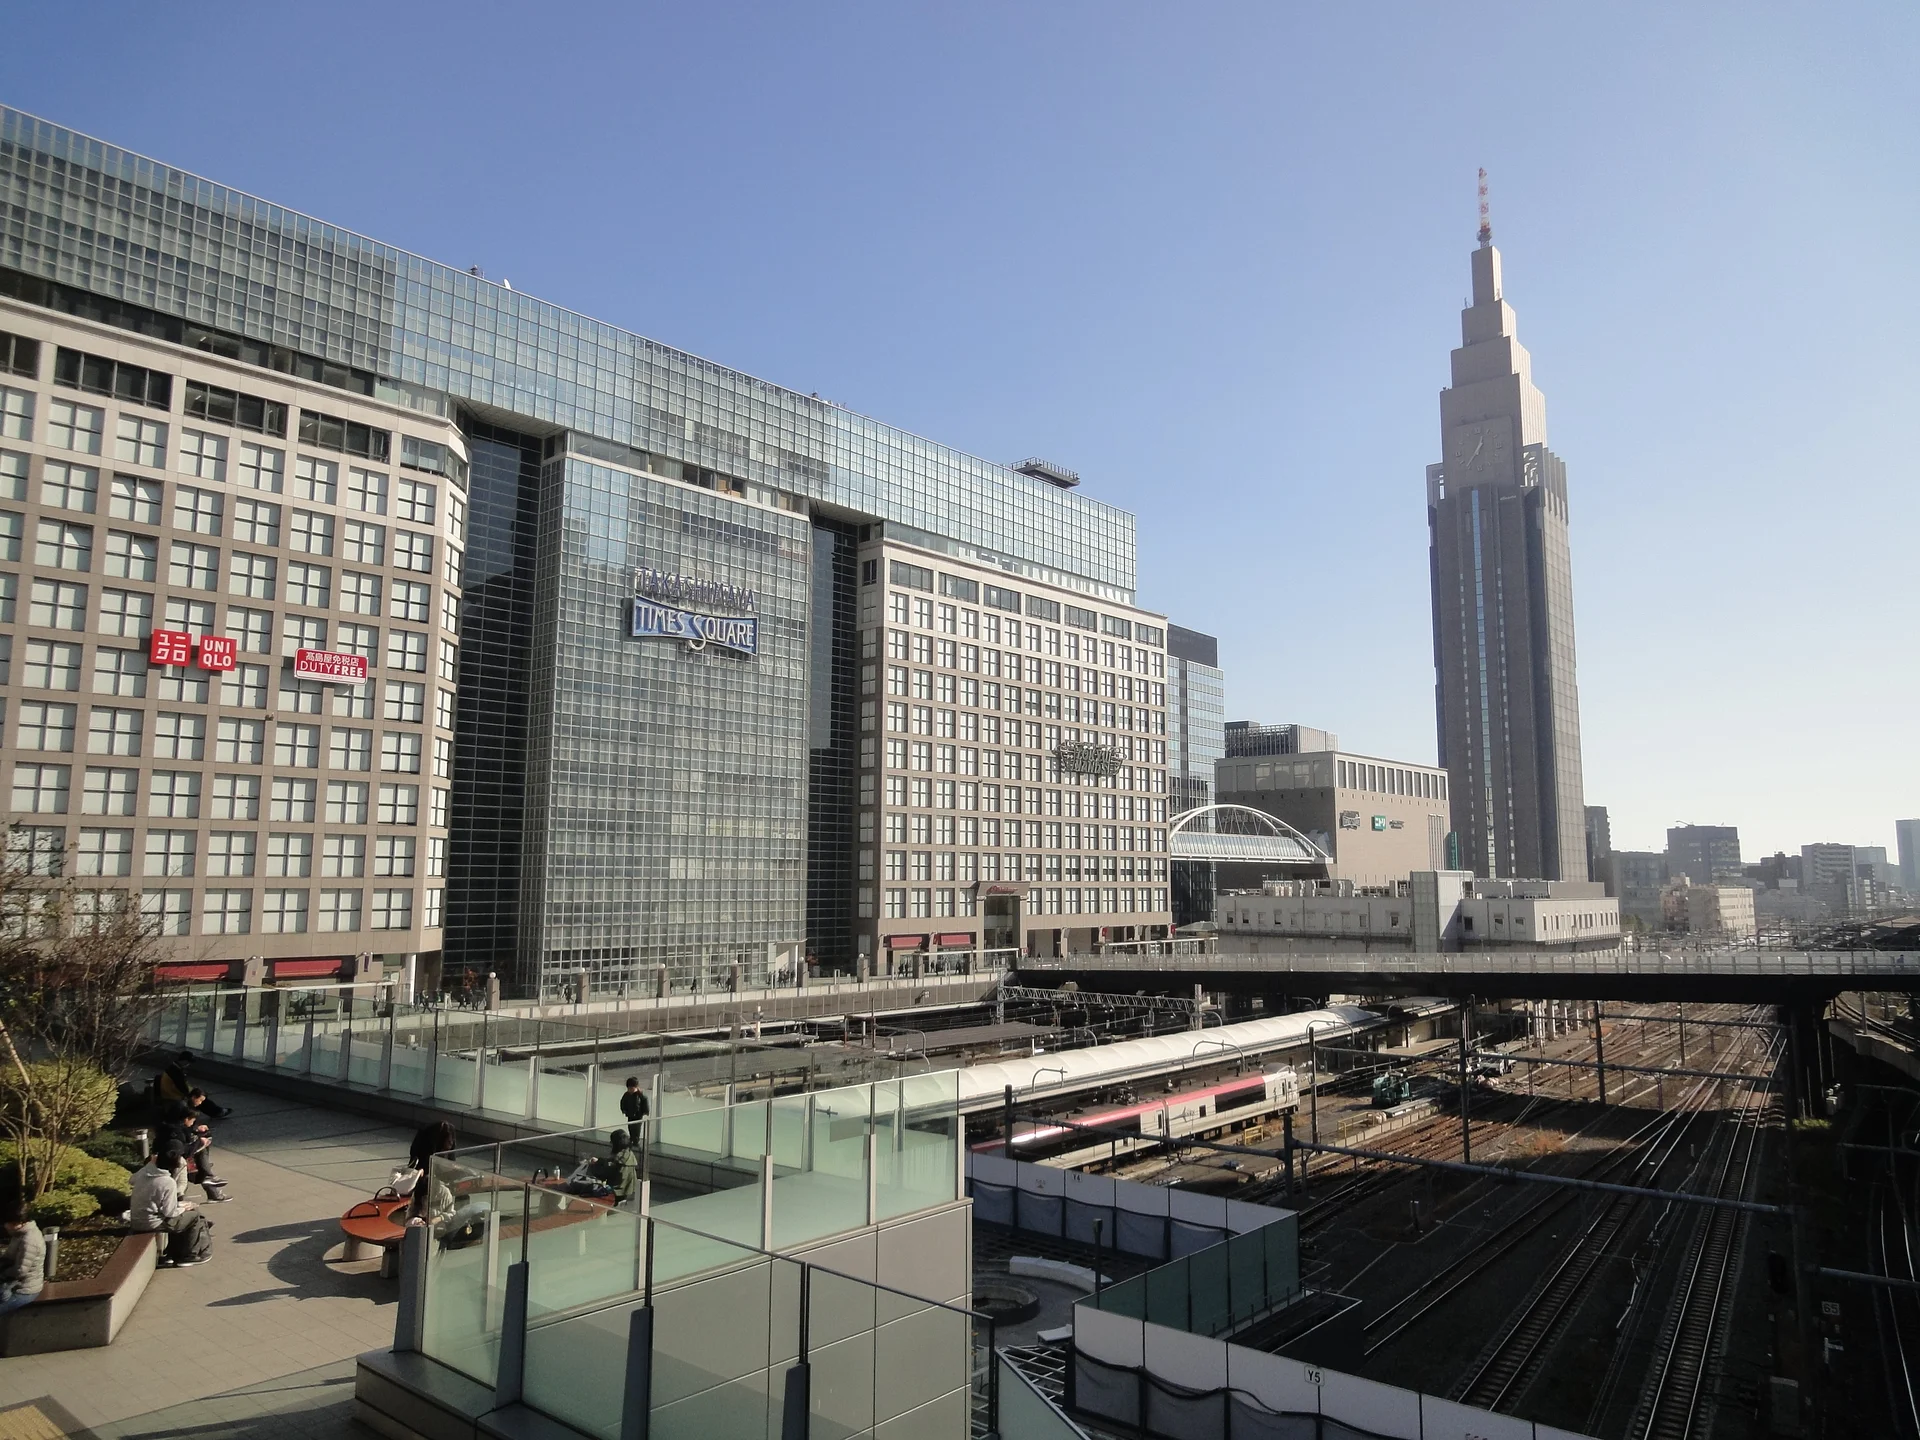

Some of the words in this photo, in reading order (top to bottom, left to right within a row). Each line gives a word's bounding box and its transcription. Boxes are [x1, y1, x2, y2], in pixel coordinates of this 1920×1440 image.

[640, 567, 755, 611] TAKASHIMAYA
[638, 604, 686, 634] TIMES
[688, 614, 755, 651] SQUARE
[158, 633, 187, 648] ユニ
[203, 639, 231, 654] UNI
[155, 647, 186, 662] クロ
[202, 653, 232, 667] QLO
[1307, 1369, 1321, 1384] Y5
